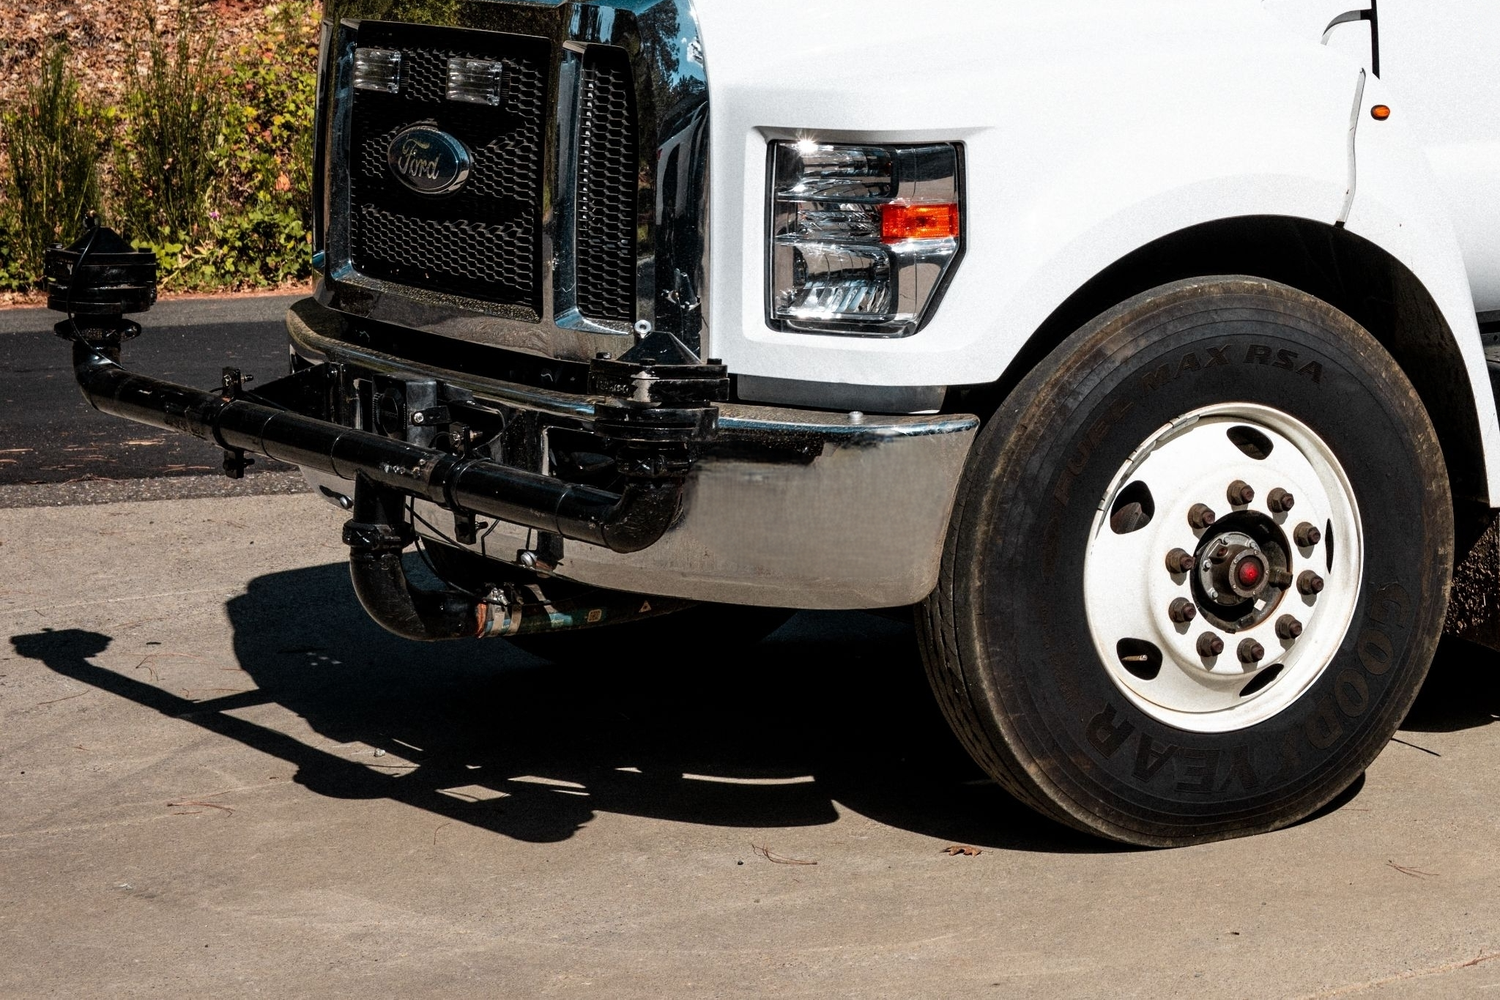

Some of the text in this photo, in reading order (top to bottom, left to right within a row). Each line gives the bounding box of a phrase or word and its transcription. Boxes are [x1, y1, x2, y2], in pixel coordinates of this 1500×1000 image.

[398, 137, 442, 180] Ford
[1142, 344, 1232, 392] MAX
[1243, 344, 1326, 385] RSA
